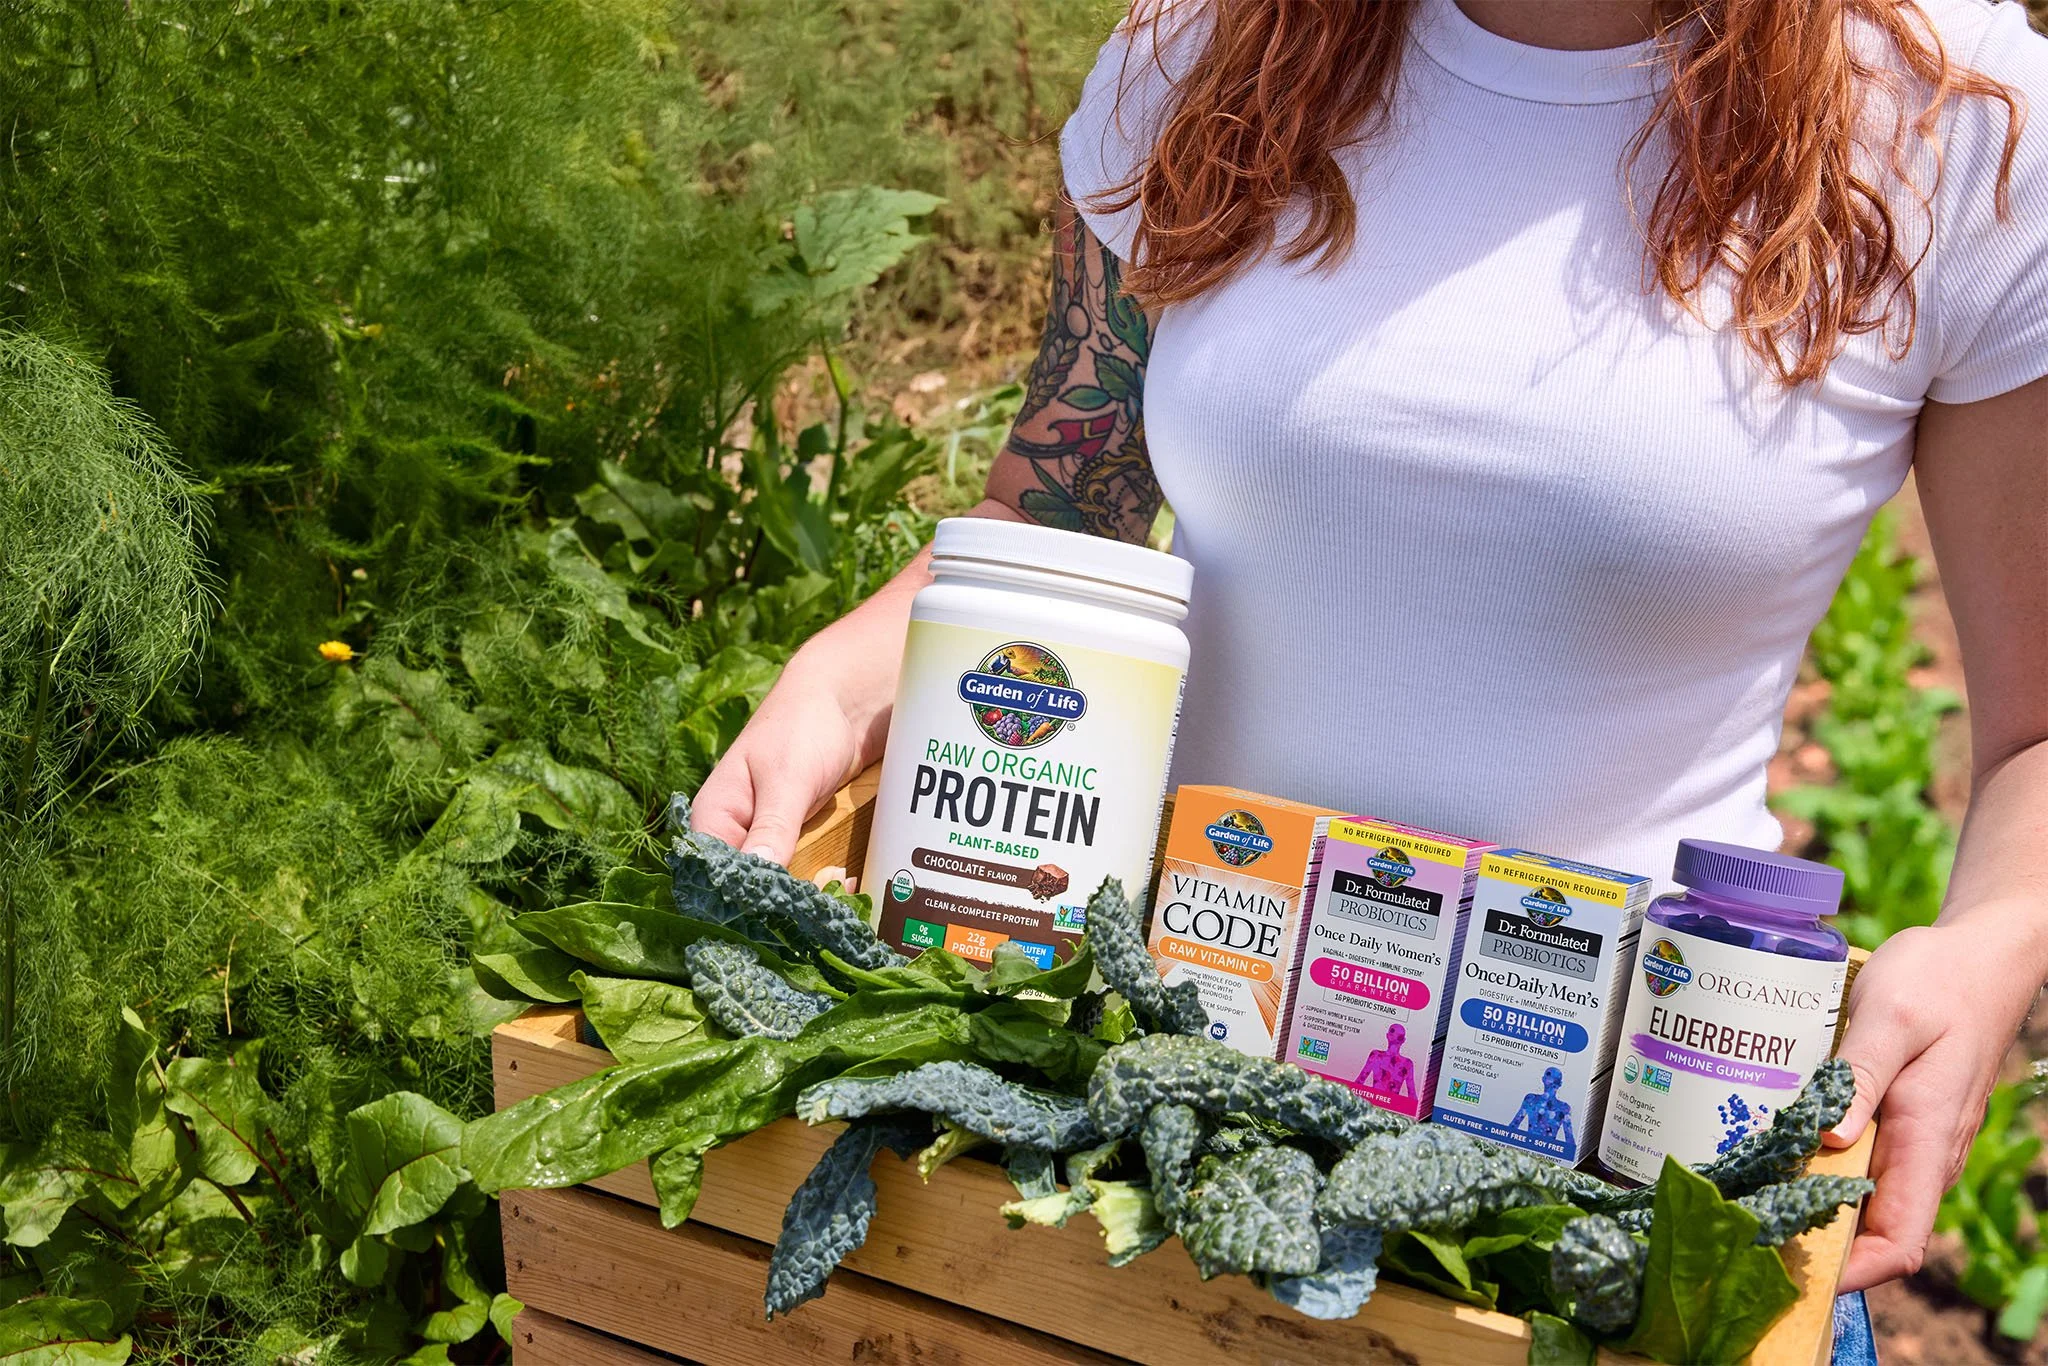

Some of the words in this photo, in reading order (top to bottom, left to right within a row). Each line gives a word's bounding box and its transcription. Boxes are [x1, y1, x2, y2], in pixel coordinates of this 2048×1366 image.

[966, 678, 1022, 701] Garden
[1027, 688, 1049, 709] of
[1048, 692, 1079, 712] Life
[925, 738, 976, 768] RAW
[982, 750, 1097, 791] ORGANIC
[909, 764, 1101, 847] PROTEIN
[948, 832, 1040, 860] PLANT-BASED
[1208, 827, 1240, 842] Garden
[1241, 835, 1253, 847] of
[1252, 838, 1270, 849] Life
[1343, 826, 1354, 836] NO
[1356, 829, 1412, 849] REFRIGERATION
[1414, 843, 1452, 858] REQUIRED
[923, 854, 985, 877] CHOCOLATE
[986, 870, 1018, 883] FLAVOR
[1369, 859, 1392, 871] Garden
[1392, 864, 1402, 875] of
[1400, 864, 1415, 876] Life
[1345, 879, 1363, 896] Dr.
[1364, 884, 1431, 912] Formulated
[1488, 864, 1500, 874] NO
[1503, 867, 1570, 889] REFRIGERATION
[1573, 884, 1618, 900] REQUIRED
[1173, 874, 1287, 920] VITAMIN
[1522, 898, 1548, 910] Garden
[1548, 903, 1559, 913] of
[1556, 904, 1571, 915] Life
[924, 897, 950, 911] CLEAN
[949, 903, 957, 912] &
[957, 905, 1001, 922] COMPLETE
[1002, 914, 1040, 928] PROTEIN
[1338, 898, 1428, 933] PROBIOTICS
[911, 933, 934, 945] SUGAR
[967, 932, 987, 947] 22g
[1162, 902, 1283, 959] CODE
[1497, 919, 1517, 937] Dr.
[1518, 925, 1590, 953] Formulated
[1169, 941, 1198, 959] RAW
[1200, 950, 1249, 972] VITAMIN
[1314, 924, 1346, 942] Once
[1349, 932, 1383, 953] Daily
[1386, 941, 1442, 967] Women's
[1493, 939, 1586, 974] PROBIOTICS
[1322, 946, 1345, 959] VAGINAL
[1348, 953, 1376, 967] DIGESTIVE
[1379, 961, 1401, 973] IMMUNE
[1643, 956, 1664, 972] Garden
[1664, 965, 1674, 978] of
[1673, 966, 1689, 980] Life
[1202, 972, 1224, 984] WHOLE
[1224, 978, 1242, 989] FOOD
[1217, 985, 1234, 994] WITH
[1330, 978, 1407, 1004] GUARANTEED
[1331, 964, 1350, 981] 50
[1353, 970, 1410, 996] BILLION
[1465, 962, 1505, 985] Once
[1506, 972, 1549, 1000] Daily
[1549, 983, 1600, 1009] Men's
[1698, 972, 1821, 1010] ORGANICS
[1199, 988, 1233, 1001] LAVONOIDS
[1199, 1000, 1216, 1010] STEM
[1335, 993, 1343, 1002] 16
[1342, 994, 1373, 1011] PROBIOTIC
[1373, 1002, 1397, 1016] STRAINS
[1479, 988, 1515, 1004] DIGESTIVE
[1520, 998, 1550, 1012] IMMUNE
[1212, 1025, 1226, 1037] NSF
[1481, 1019, 1564, 1046] GUARANTEED
[1483, 1005, 1503, 1022] 50
[1505, 1011, 1567, 1039] BILLION
[1481, 1033, 1490, 1042] 15
[1490, 1034, 1529, 1052] PROBIOTIC
[1528, 1043, 1559, 1060] STRAINS
[1649, 1006, 1797, 1066] ELDERBERRY
[1453, 1055, 1471, 1066] HELPS
[1471, 1060, 1493, 1070] REDUCE
[1455, 1045, 1483, 1058] SUPPORTS
[1483, 1052, 1501, 1063] COLON
[1665, 1050, 1713, 1073] IMMUNE
[1452, 1063, 1485, 1077] OCCASIONAL
[1352, 1087, 1375, 1100] GLUTEN
[1375, 1093, 1391, 1104] FREE
[1629, 1095, 1656, 1113] Organic
[1442, 1113, 1467, 1127] GLUTEN
[1467, 1120, 1483, 1131] FREE
[1490, 1127, 1510, 1138] DAIRY
[1510, 1132, 1527, 1143] FREE
[1534, 1139, 1548, 1149] SOY
[1547, 1143, 1565, 1153] FREE
[1613, 1113, 1622, 1123] and
[1622, 1116, 1647, 1134] Vitamin
[1647, 1128, 1654, 1138] C
[1644, 1114, 1661, 1127] Zinc
[1606, 1145, 1624, 1161] GLUTEN
[1624, 1156, 1639, 1168] FREE
[1620, 1136, 1632, 1147] with
[1633, 1141, 1646, 1152] Real
[1647, 1147, 1663, 1159] Fruit
